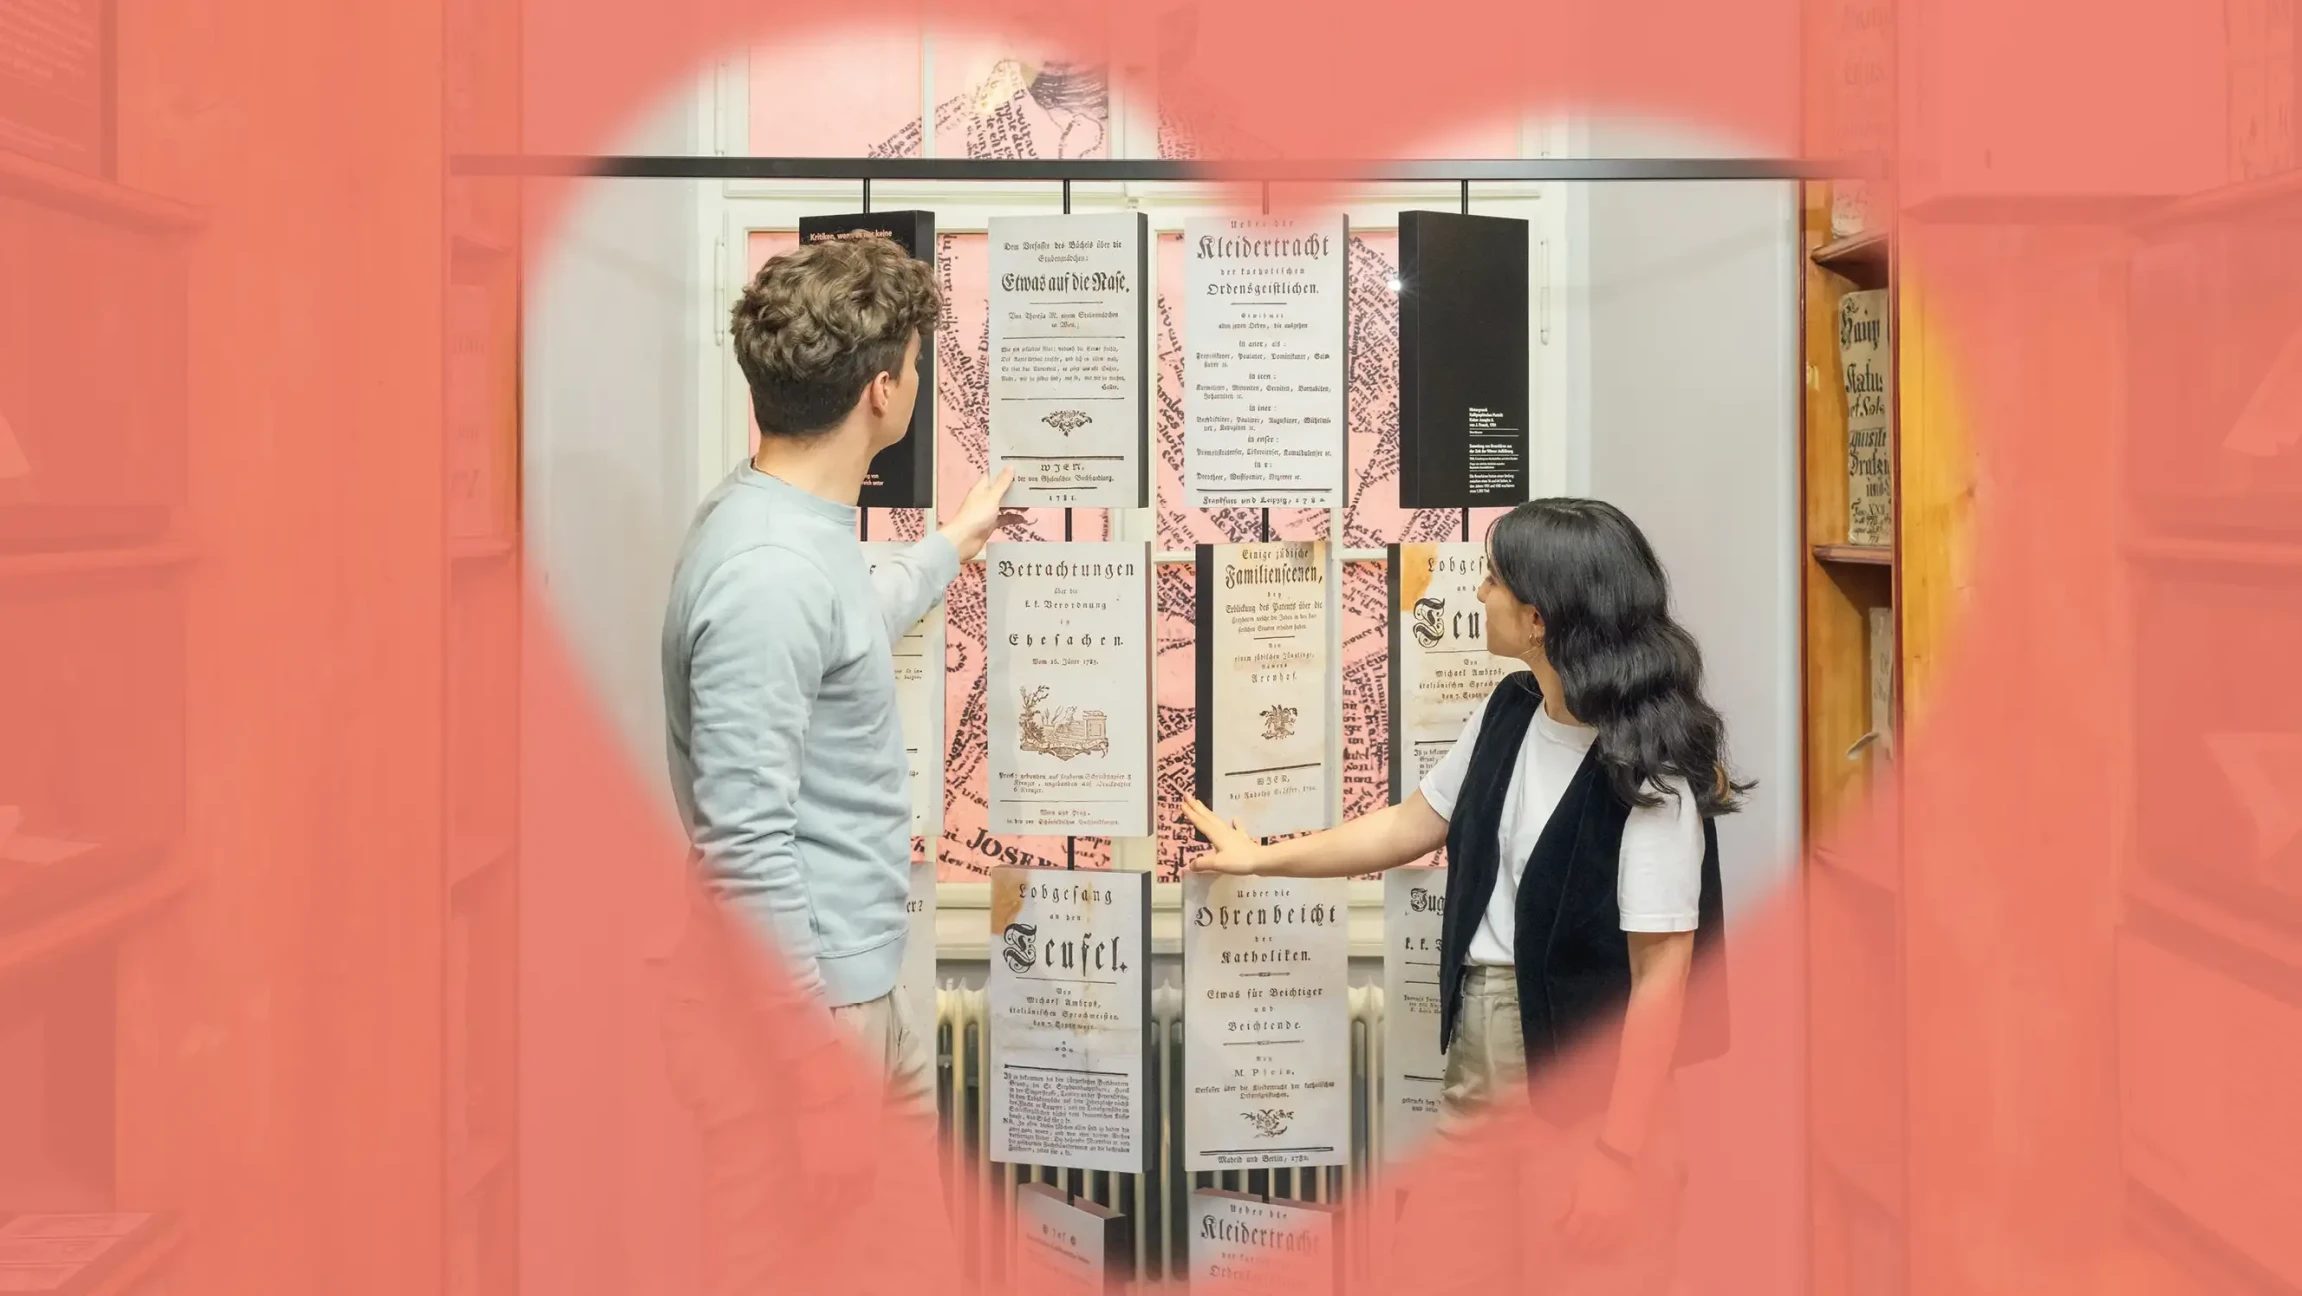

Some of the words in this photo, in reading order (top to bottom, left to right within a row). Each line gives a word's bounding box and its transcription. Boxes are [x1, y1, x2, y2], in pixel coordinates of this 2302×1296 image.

[1054, 240, 1065, 249] des
[1112, 239, 1122, 248] die
[1196, 232, 1330, 261] Kleidertracht
[1001, 272, 1047, 293] Etwas
[1049, 271, 1070, 294] auf
[1071, 271, 1090, 293] die
[1091, 270, 1130, 294] Nase.
[1206, 281, 1320, 297] Ordensgeistlichen.
[1241, 548, 1272, 561] Einige
[998, 559, 1136, 580] Betrachtungen
[1225, 562, 1323, 589] Familienscenen,
[1427, 555, 1485, 576] Lobges
[1043, 599, 1107, 610] Verordnung
[1412, 597, 1481, 649] Teu
[1008, 632, 1125, 648] Ehesachen.
[1018, 882, 1113, 906] Lobgesang
[1274, 888, 1291, 897] die
[1193, 902, 1337, 930] Ohrenbeicht
[1002, 922, 1129, 977] Teufel.
[1220, 948, 1311, 964] Katholiken.
[1206, 988, 1241, 1000] Etwas
[1247, 987, 1264, 999] für
[1269, 985, 1324, 999] Beichtiger
